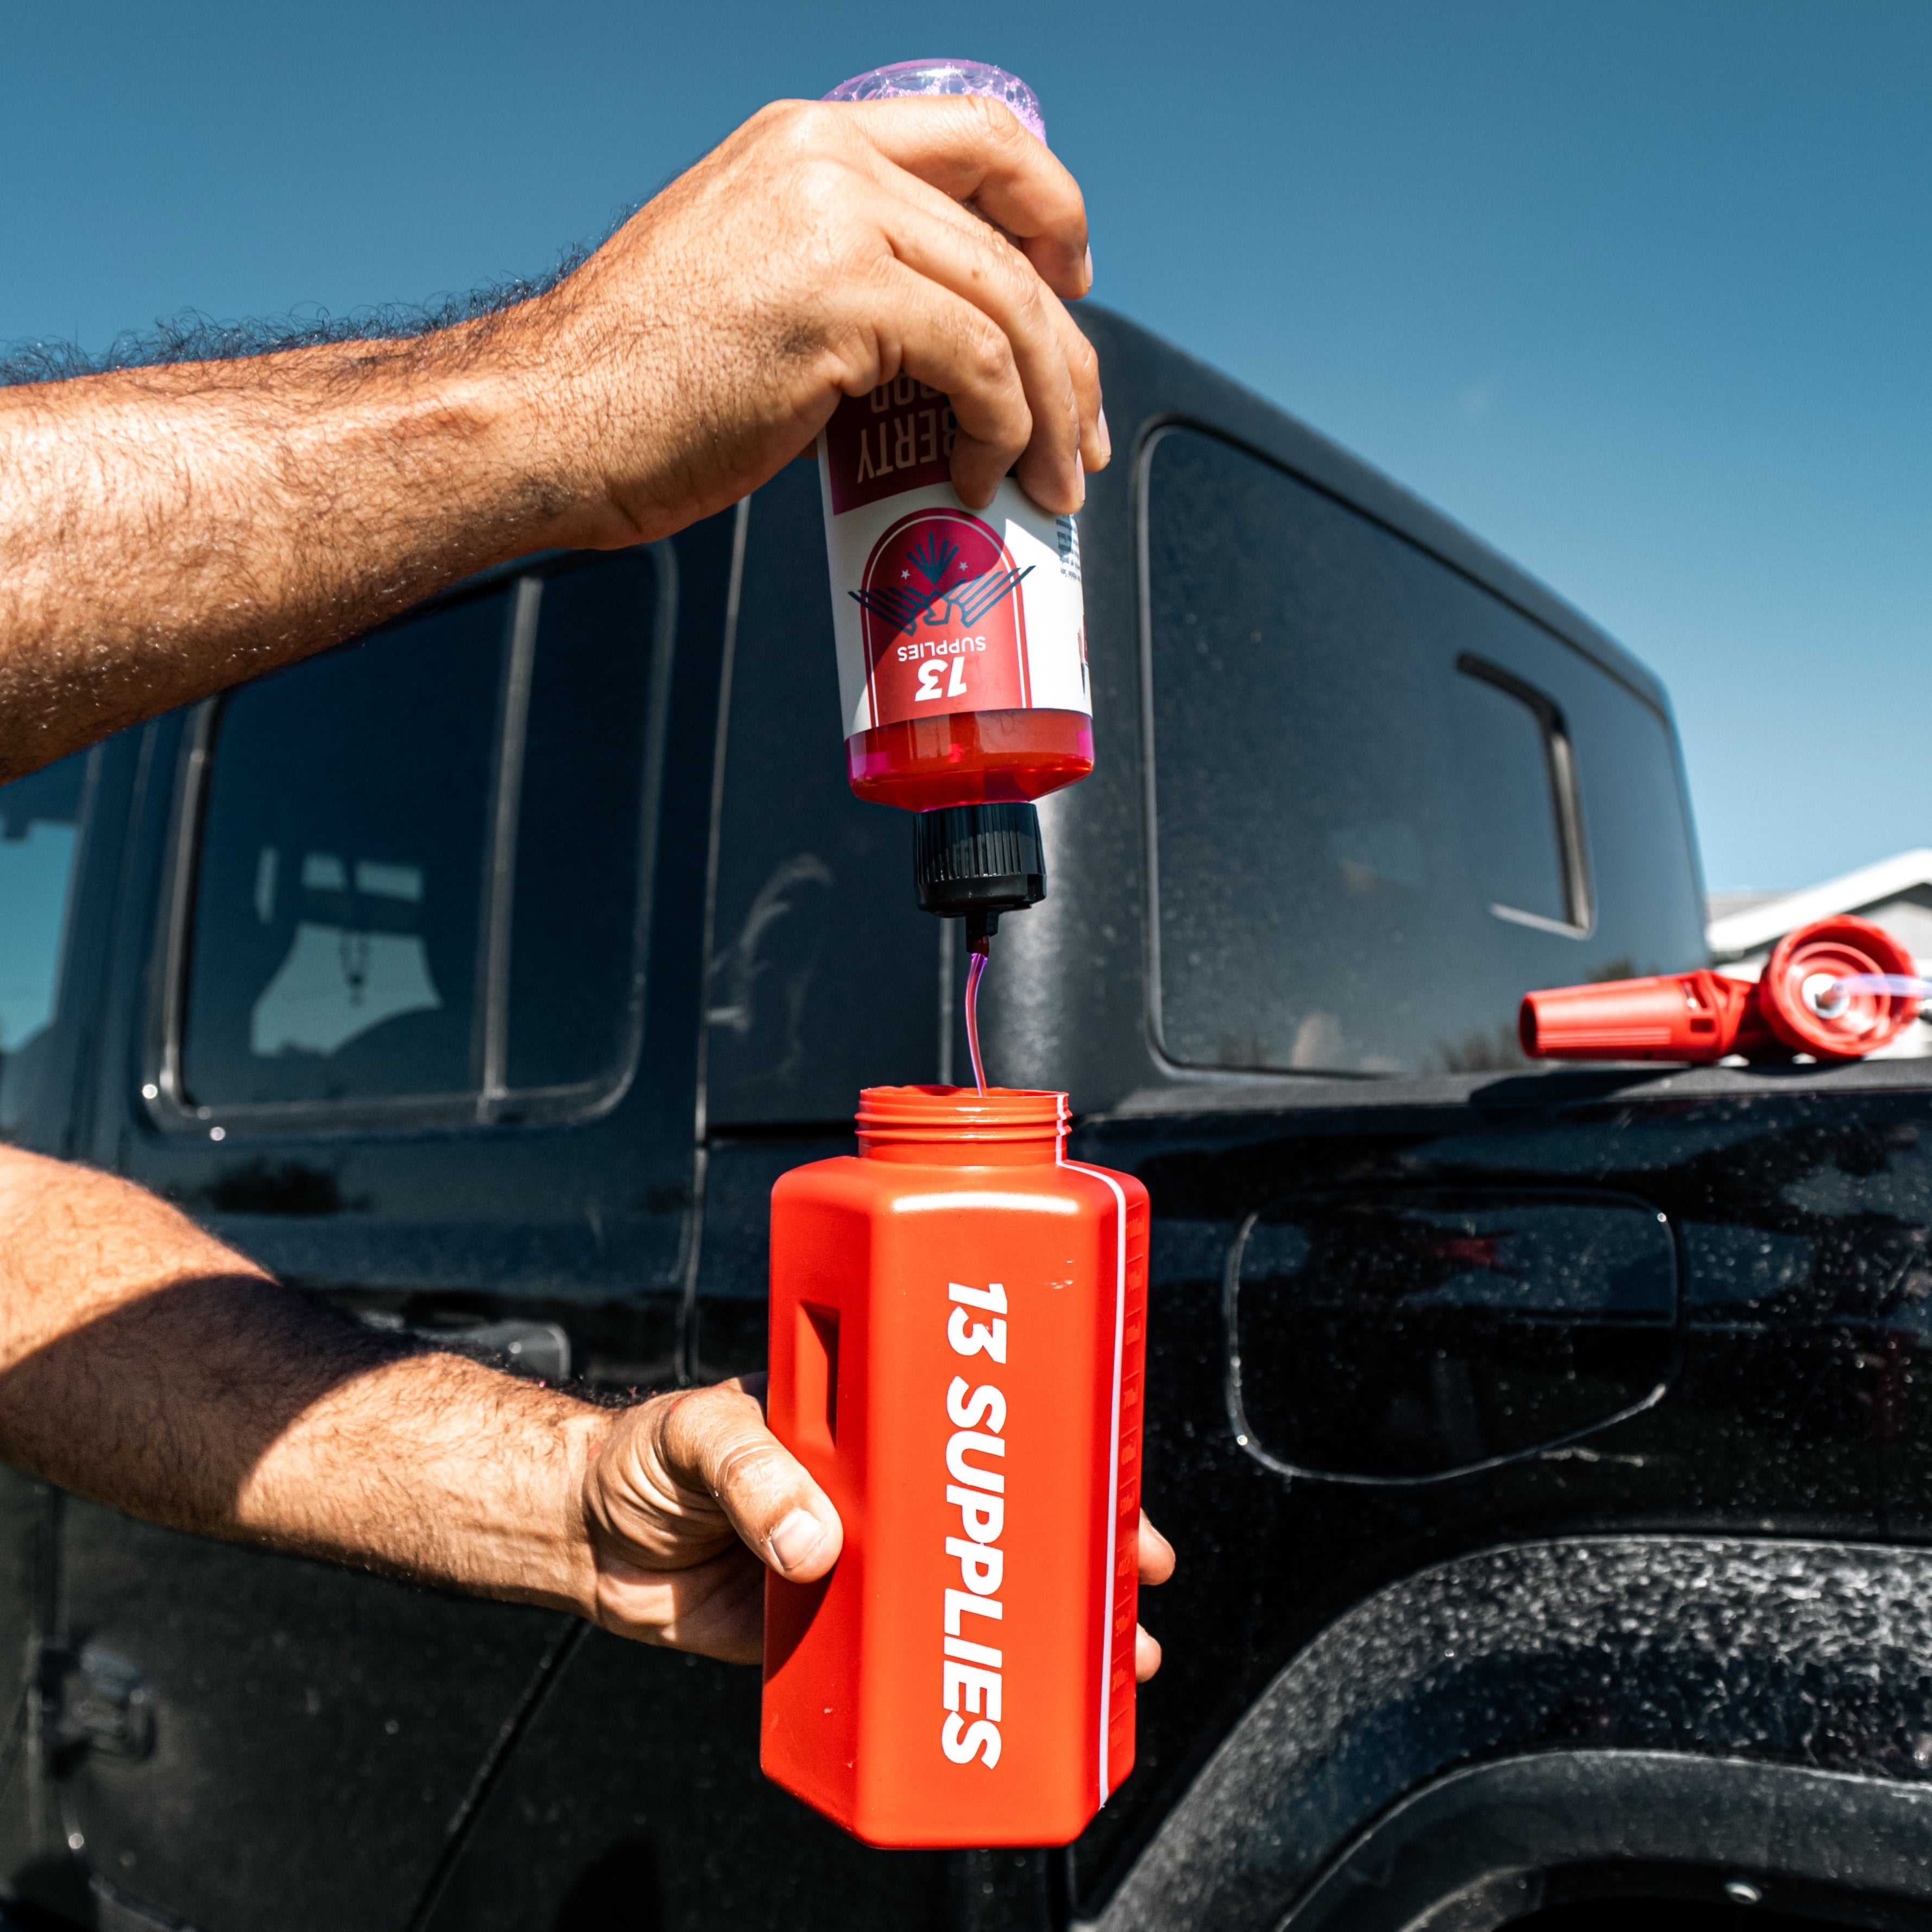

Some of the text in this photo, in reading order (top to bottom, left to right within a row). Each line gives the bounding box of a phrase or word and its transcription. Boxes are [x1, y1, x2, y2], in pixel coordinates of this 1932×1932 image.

[857, 405, 959, 483] BERTY
[897, 636, 986, 662] SUPPLIES
[914, 656, 968, 702] 13
[942, 1282, 1008, 1769] 13 SUPPLIES
